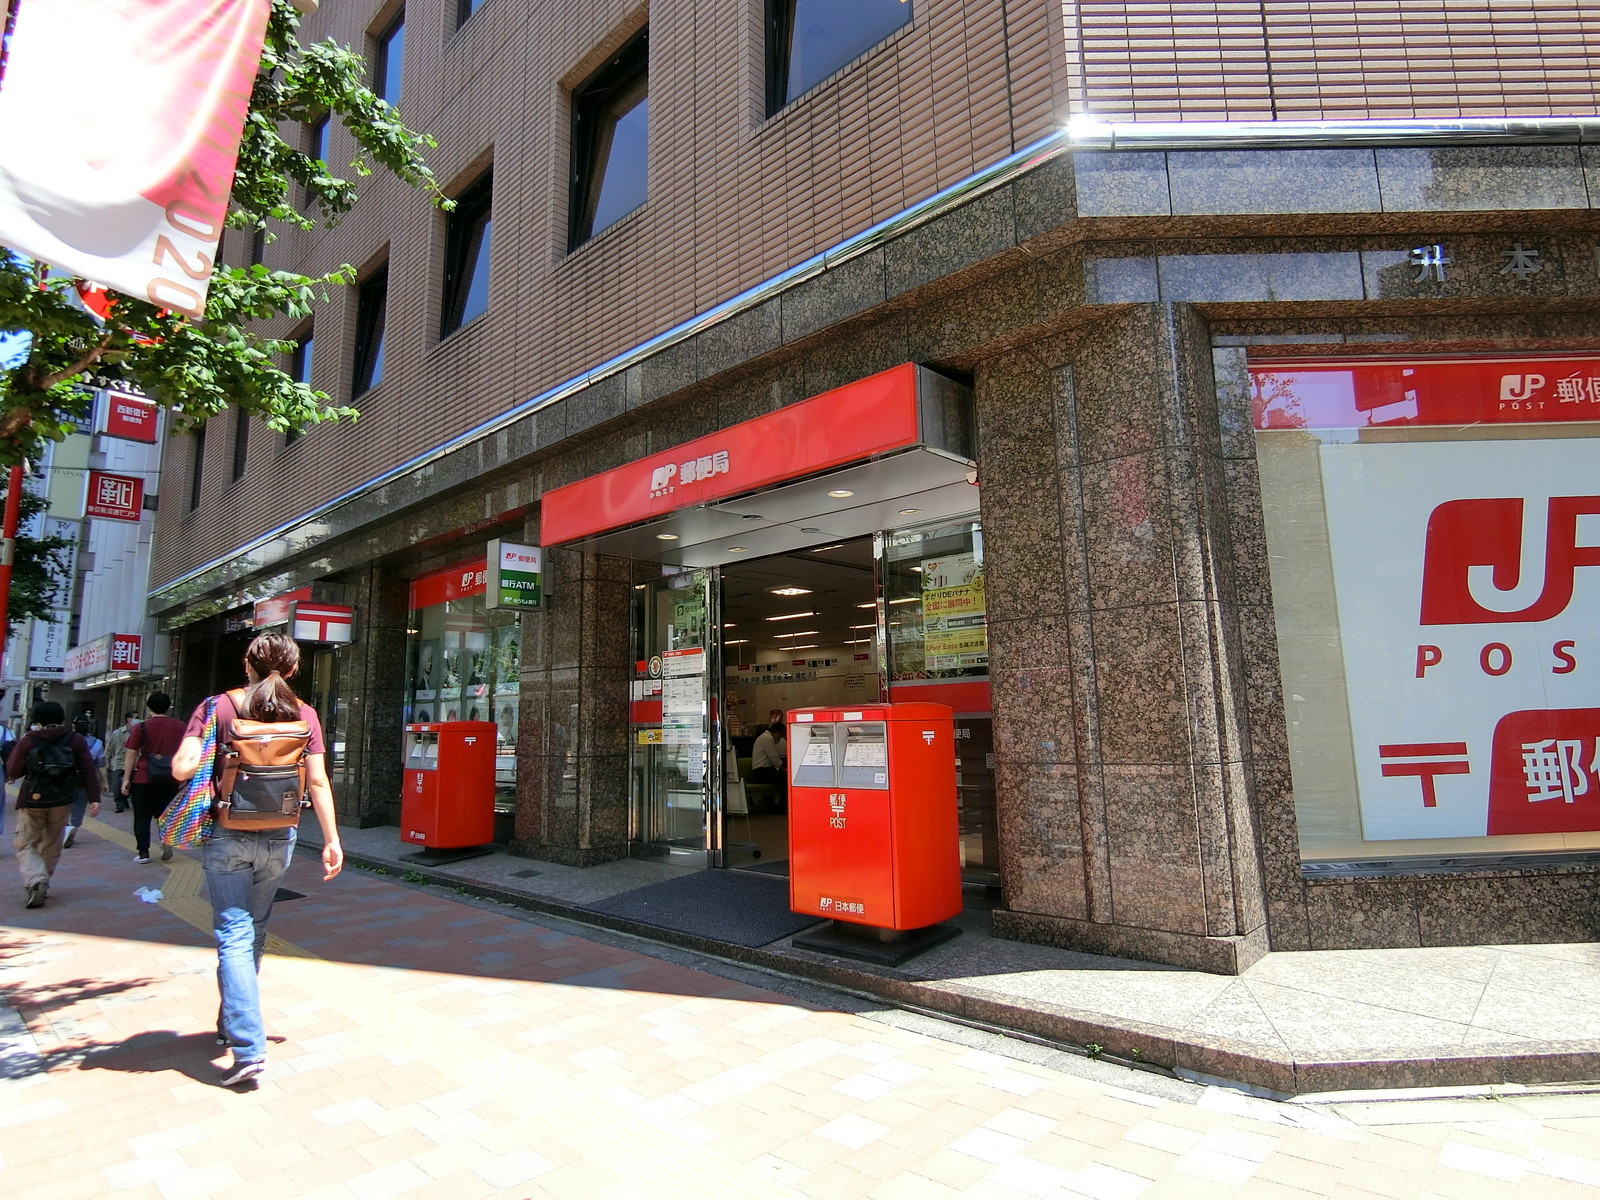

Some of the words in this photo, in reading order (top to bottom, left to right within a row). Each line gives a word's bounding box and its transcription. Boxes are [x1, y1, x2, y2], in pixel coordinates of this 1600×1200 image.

[146, 160, 231, 322] 2020
[1411, 243, 1600, 284] 升本
[1500, 374, 1546, 400] JP
[117, 404, 149, 419] 西新宿七
[1499, 402, 1545, 411] POST
[680, 450, 729, 485] 郵便局
[101, 479, 130, 505] 靴
[650, 486, 675, 499] POST
[518, 555, 537, 564] 郵便局
[501, 578, 535, 590] 銀行ATM
[114, 641, 139, 664] 靴
[1521, 738, 1600, 804] 郵
[829, 793, 846, 807] 郵便
[829, 817, 847, 829] POST
[834, 900, 865, 914] 日本郵便
